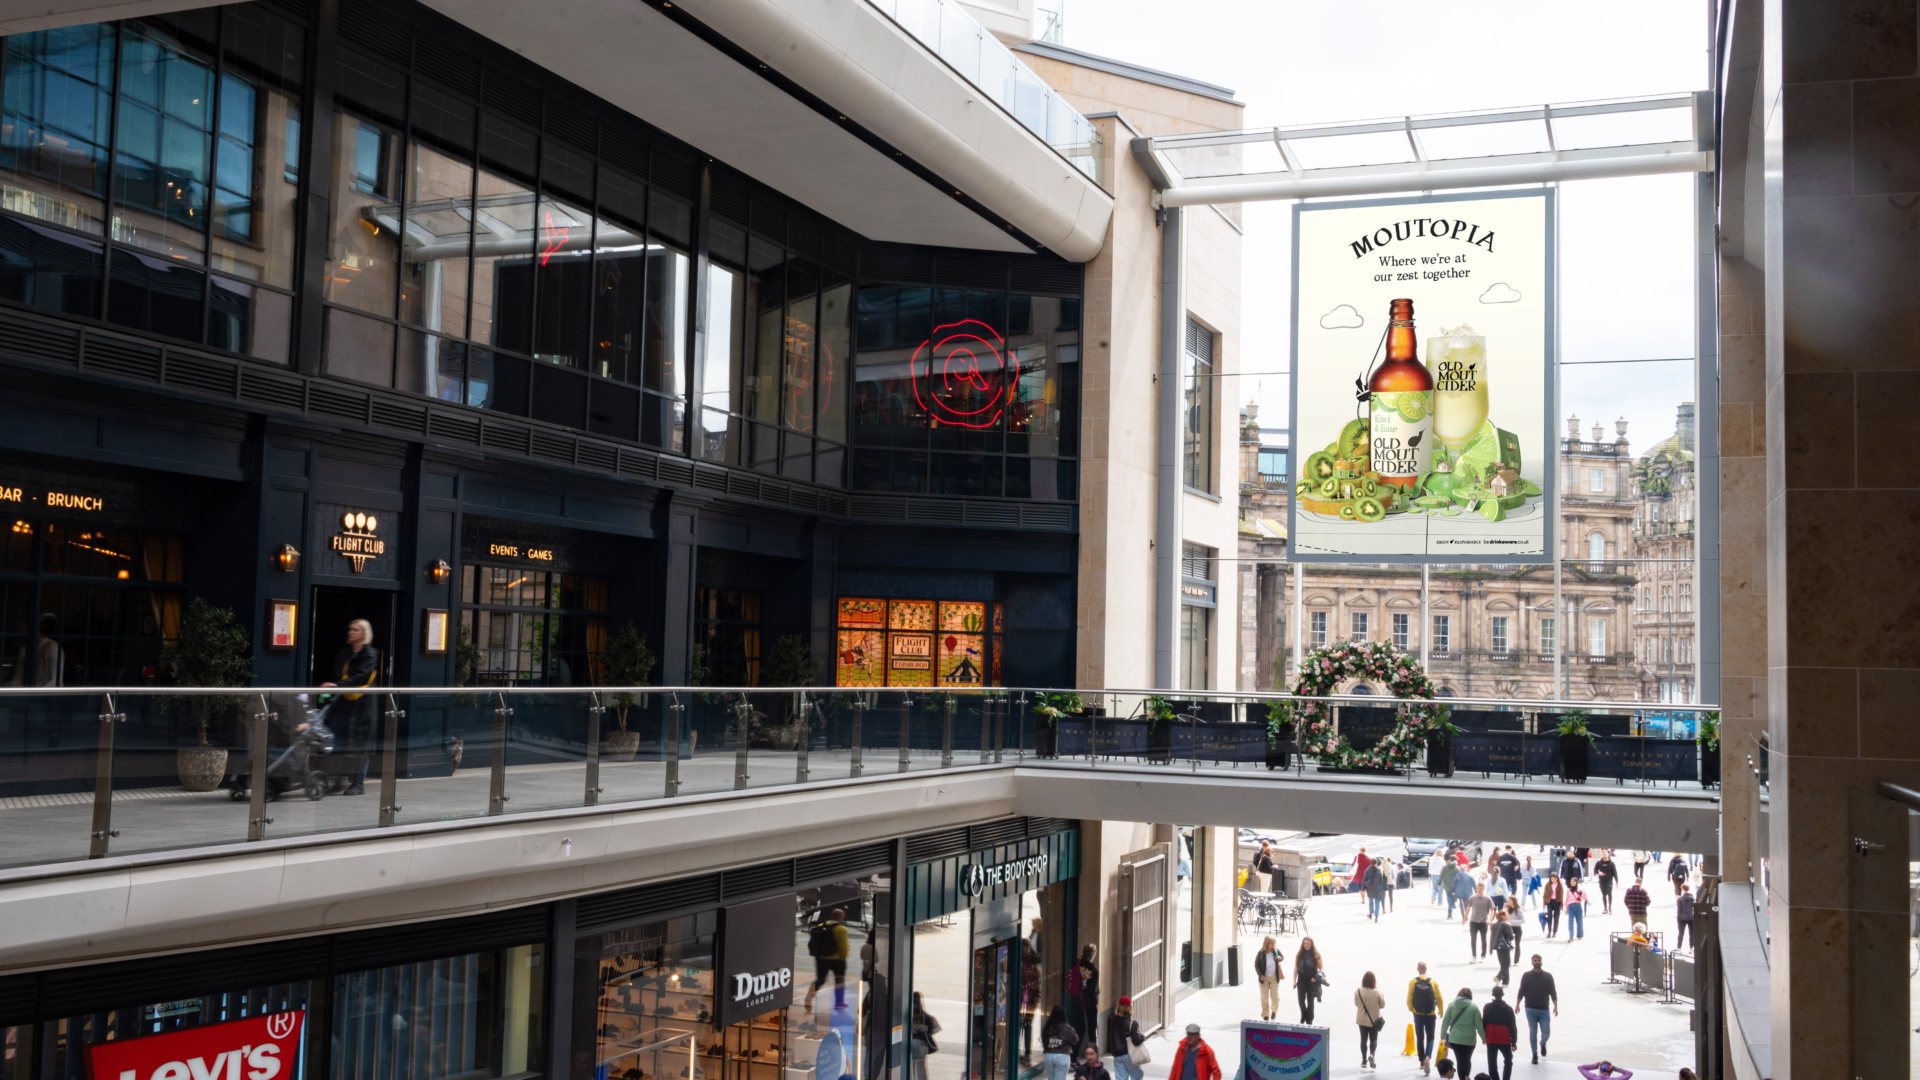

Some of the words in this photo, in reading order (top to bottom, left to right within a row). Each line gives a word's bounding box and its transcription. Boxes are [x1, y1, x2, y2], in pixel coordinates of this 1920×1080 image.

[1349, 218, 1495, 260] MOUTOPIA
[1379, 255, 1416, 267] Where
[1421, 253, 1451, 265] we're
[1454, 253, 1467, 263] at
[1374, 272, 1393, 282] our
[1396, 270, 1418, 281] zest
[1422, 267, 1471, 281] together
[1437, 361, 1463, 371] OLD
[1438, 370, 1477, 380] MOUT
[1436, 380, 1476, 391] CIDER
[1374, 414, 1391, 423] Kiwi
[1380, 424, 1398, 433] lime
[1373, 437, 1401, 449] OLD
[1374, 448, 1419, 460] MOUT
[1373, 460, 1418, 473] CIDER
[47, 492, 102, 511] BRUNCH
[333, 536, 363, 552] FLIGHT
[364, 539, 384, 554] CLUB
[490, 543, 518, 557] EVENTS
[528, 548, 553, 561] GAMES
[896, 637, 927, 646] FLIGHT
[900, 645, 923, 654] CLUB
[986, 865, 1003, 887] THE
[1005, 859, 1027, 882] BODY
[1027, 854, 1048, 876] SHOP
[732, 967, 791, 1002] Dune
[746, 993, 774, 1008] LONDON
[1253, 1034, 1310, 1046] MOONWALK
[1249, 1053, 1262, 1065] SAT
[1267, 1065, 1301, 1075] SEPTEMBER
[1300, 1057, 1317, 1070] 2024
